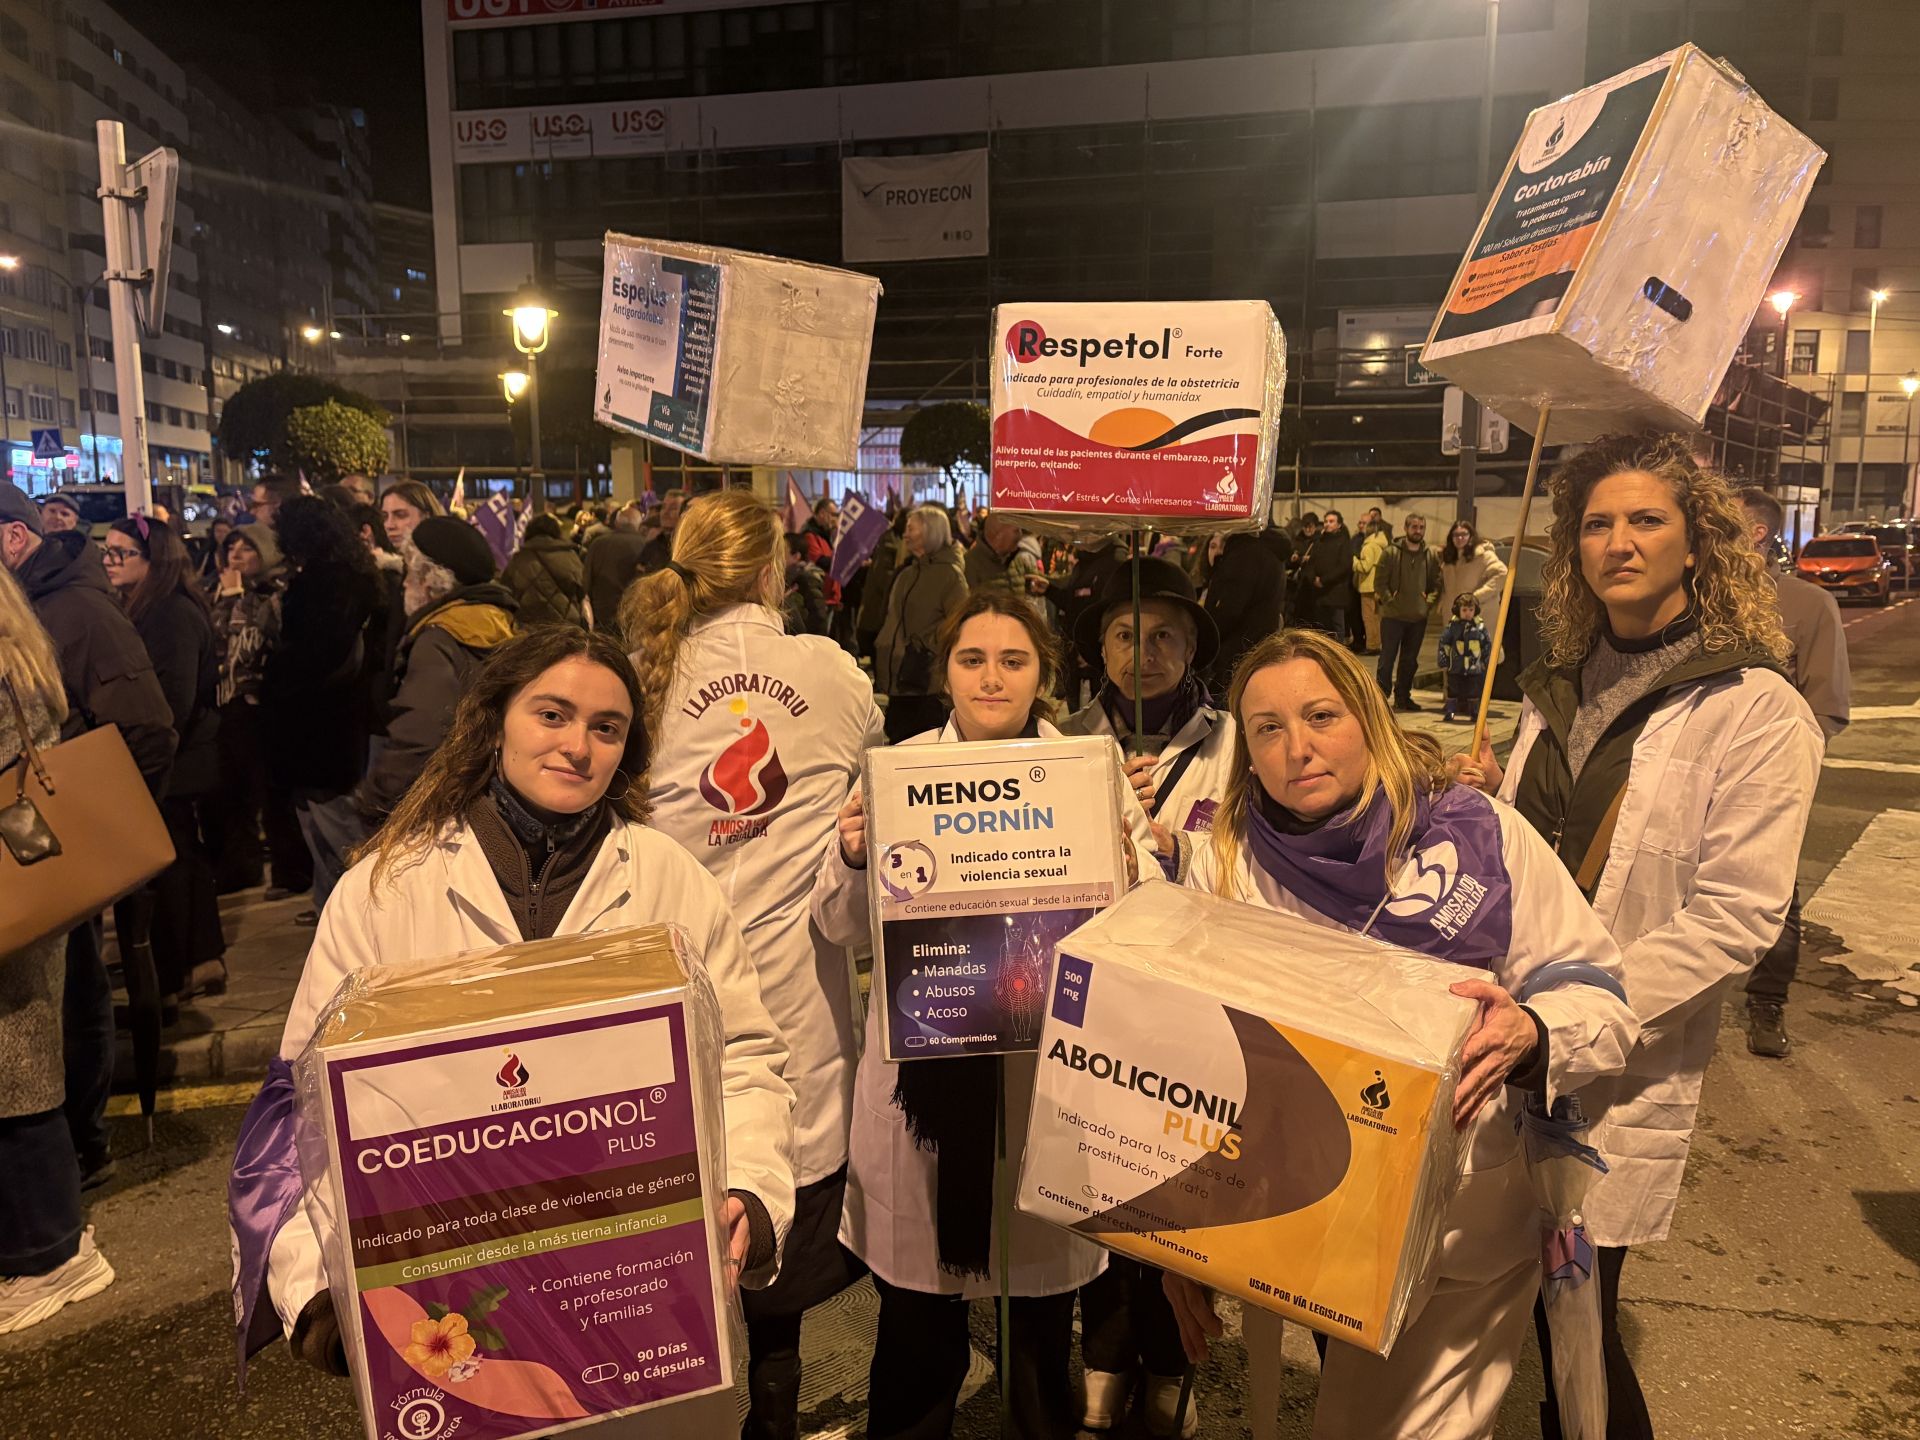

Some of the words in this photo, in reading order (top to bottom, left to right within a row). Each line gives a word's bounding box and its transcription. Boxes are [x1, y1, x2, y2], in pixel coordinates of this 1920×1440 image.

[1513, 155, 1612, 203] Cortorabín
[885, 183, 972, 206] PROYECON
[1516, 197, 1560, 219] Tratamiento
[1560, 188, 1587, 203] contra
[1185, 345, 1223, 358] Forte
[1049, 375, 1075, 387] para
[1076, 374, 1148, 388] profesionales
[1151, 377, 1165, 387] de
[1167, 377, 1178, 387] la
[1180, 377, 1240, 389] obstetricia
[1036, 387, 1083, 400] Cuidadín,
[1086, 390, 1131, 402] empatiol
[1133, 393, 1140, 402] y
[1142, 390, 1201, 402] humanidax
[661, 405, 670, 416] Vía
[653, 419, 674, 433] mental
[994, 458, 1039, 470] puerperio,
[1040, 459, 1082, 470] evitando:
[995, 445, 1019, 455] Alivio
[1020, 446, 1042, 456] total
[1043, 447, 1054, 456] de
[1056, 447, 1069, 457] las
[1070, 448, 1113, 460] pacientes
[1115, 449, 1151, 460] durante
[1152, 451, 1161, 460] el
[1163, 452, 1210, 465] embarazo,
[1213, 454, 1238, 466] parto
[1239, 456, 1246, 466] y
[1007, 489, 1060, 501] Humillaciones
[1076, 492, 1100, 503] Estrés
[1115, 494, 1141, 504] Cortes
[1142, 494, 1193, 507] innecesarios
[682, 673, 810, 720] LLABORATORIU
[906, 778, 1021, 807] MENOS
[933, 801, 1055, 836] PORNÍN
[708, 834, 721, 847] LA
[950, 850, 1009, 865] Indicado
[1011, 848, 1056, 861] contra
[1058, 846, 1072, 857] la
[890, 853, 903, 869] 3
[900, 870, 912, 880] en
[915, 866, 928, 883] 1
[960, 868, 1021, 883] violencia
[1024, 865, 1068, 879] sexual
[904, 901, 947, 914] Contiene
[949, 899, 997, 912] educación
[999, 897, 1030, 908] sexual
[1032, 895, 1060, 906] desde
[1062, 894, 1071, 904] la
[1072, 891, 1110, 903] infancia
[911, 943, 971, 958] Elimina:
[924, 962, 987, 978] Manadas
[1064, 970, 1083, 985] 500
[925, 984, 976, 999] Abusos
[1062, 986, 1080, 1002] mg
[926, 1006, 968, 1020] Acoso
[929, 1036, 940, 1045] 60
[941, 1033, 998, 1045] Comprimidos
[1047, 1038, 1243, 1131] ABOLICIONIL
[1346, 1112, 1398, 1135] LABORATORIOS
[607, 1132, 657, 1155] PLUS
[1162, 1110, 1243, 1161] PLUS
[1057, 1107, 1116, 1141] Indicado
[1119, 1132, 1152, 1155] para
[1156, 1144, 1177, 1164] los
[1180, 1157, 1222, 1181] casos
[1226, 1173, 1246, 1190] de
[1078, 1140, 1158, 1180] prostitución
[357, 1226, 423, 1251] Indicado
[426, 1220, 460, 1241] para
[463, 1210, 498, 1228] toda
[501, 1203, 537, 1221] clase
[540, 1198, 559, 1213] de
[561, 1186, 624, 1208] violencia
[626, 1181, 645, 1196] de
[648, 1171, 696, 1194] género
[1101, 1192, 1114, 1205] 84
[1116, 1199, 1187, 1234] Comprimidos
[1037, 1185, 1089, 1215] Contiene
[1092, 1209, 1148, 1239] derechos
[1150, 1231, 1209, 1264] humanos
[401, 1252, 473, 1279] Consumir
[476, 1243, 520, 1263] desde
[522, 1239, 535, 1253] la
[538, 1231, 569, 1250] más
[571, 1225, 612, 1244] tierna
[614, 1212, 668, 1236] infancia
[541, 1269, 613, 1294] Contiene
[615, 1249, 694, 1278] formación
[559, 1300, 570, 1312] a
[572, 1276, 669, 1311] profesorado
[1249, 1277, 1272, 1295] USAR
[1273, 1286, 1291, 1301] POR
[1292, 1294, 1307, 1309] VÍA
[1309, 1300, 1363, 1332] LEGISLATIVA
[579, 1316, 591, 1332] y
[592, 1302, 654, 1326] familias
[637, 1349, 654, 1364] 90
[657, 1340, 688, 1359] Días
[622, 1370, 641, 1384] 90
[643, 1354, 706, 1380] Cápsulas
[390, 1386, 446, 1411] Fórmula
